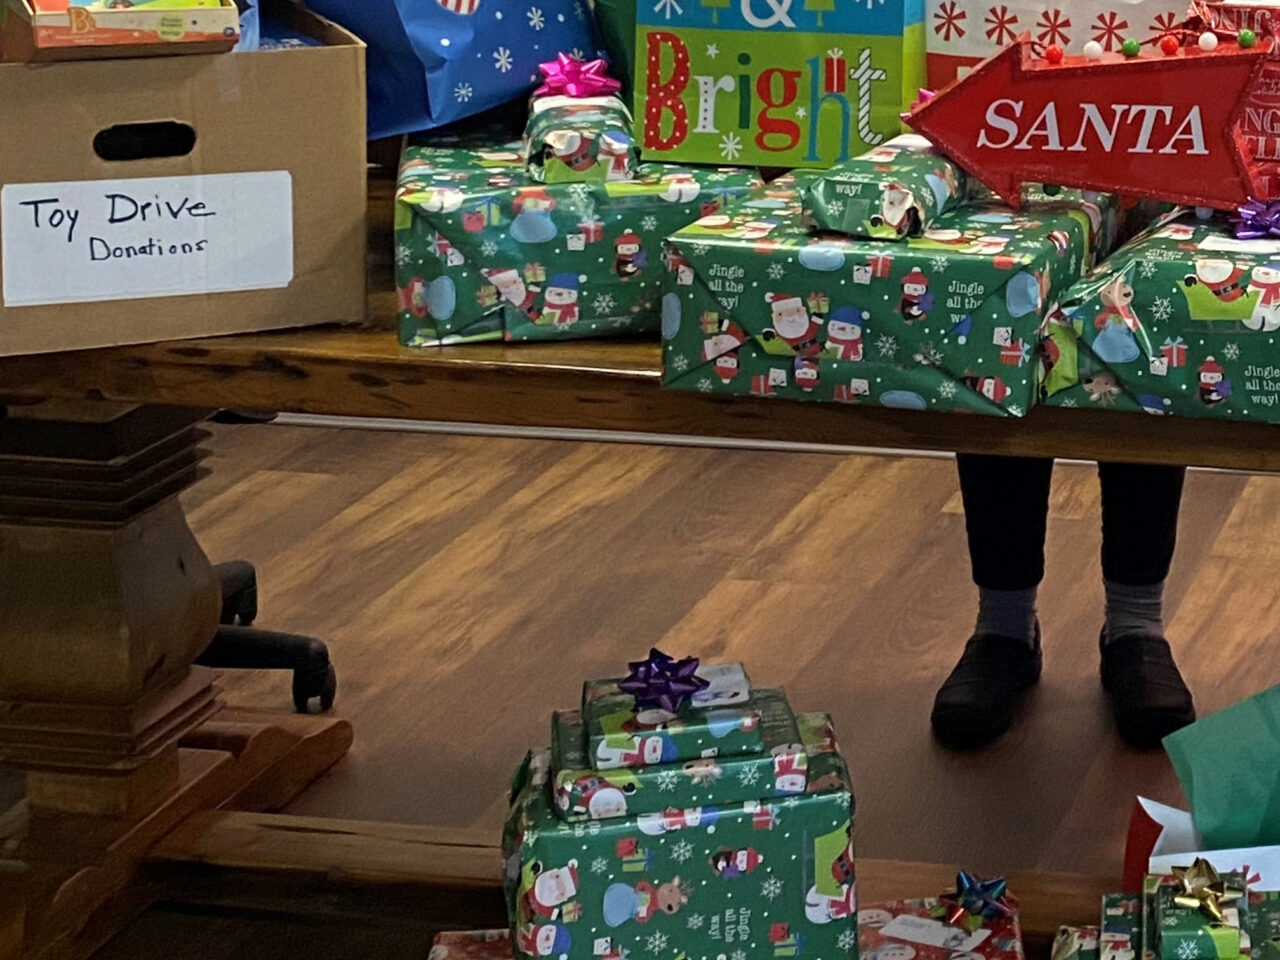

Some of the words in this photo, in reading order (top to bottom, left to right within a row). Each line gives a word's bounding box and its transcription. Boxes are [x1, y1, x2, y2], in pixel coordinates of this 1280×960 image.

[644, 32, 886, 163] Bright
[976, 98, 1210, 155] SANTA
[836, 184, 862, 198] way!
[19, 198, 79, 242] Toy
[104, 194, 217, 224] Drive
[89, 237, 208, 261] Donations
[709, 264, 745, 281] Jingle
[727, 280, 744, 292] the
[948, 281, 985, 297] Jingle
[946, 296, 962, 309] all
[1245, 366, 1280, 381] Jingle
[1245, 380, 1261, 392] all
[1251, 393, 1279, 406] way!
[725, 908, 737, 922] all
[738, 907, 751, 941] Jingle
[725, 924, 737, 943] the
